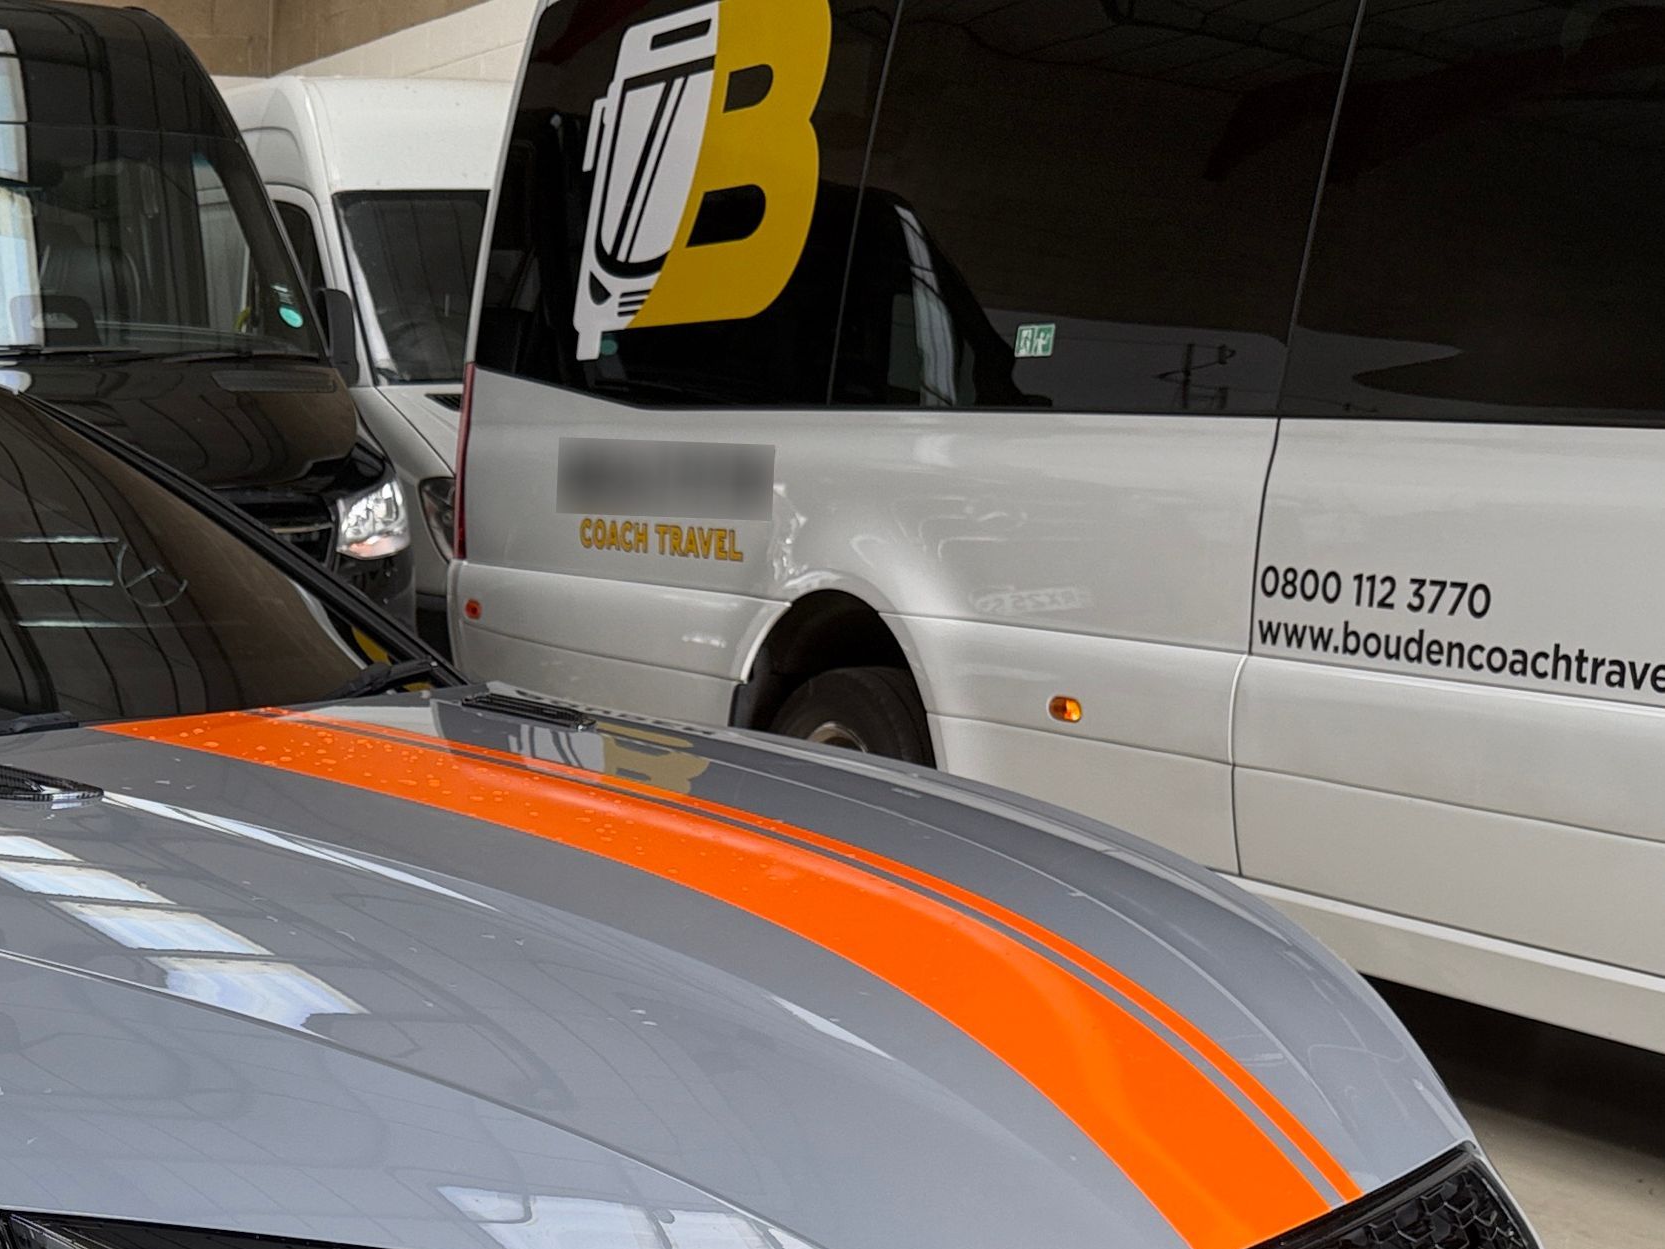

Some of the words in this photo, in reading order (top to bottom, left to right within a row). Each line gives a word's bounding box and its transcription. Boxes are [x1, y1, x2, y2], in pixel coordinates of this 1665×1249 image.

[624, 0, 833, 330] B
[579, 517, 649, 554] COACH
[654, 523, 744, 563] TRAVEL
[1260, 565, 1342, 604] 0800
[1352, 573, 1397, 610] 112
[1406, 578, 1491, 619] 3770
[1258, 619, 1665, 694] www.boudencoachtrave
